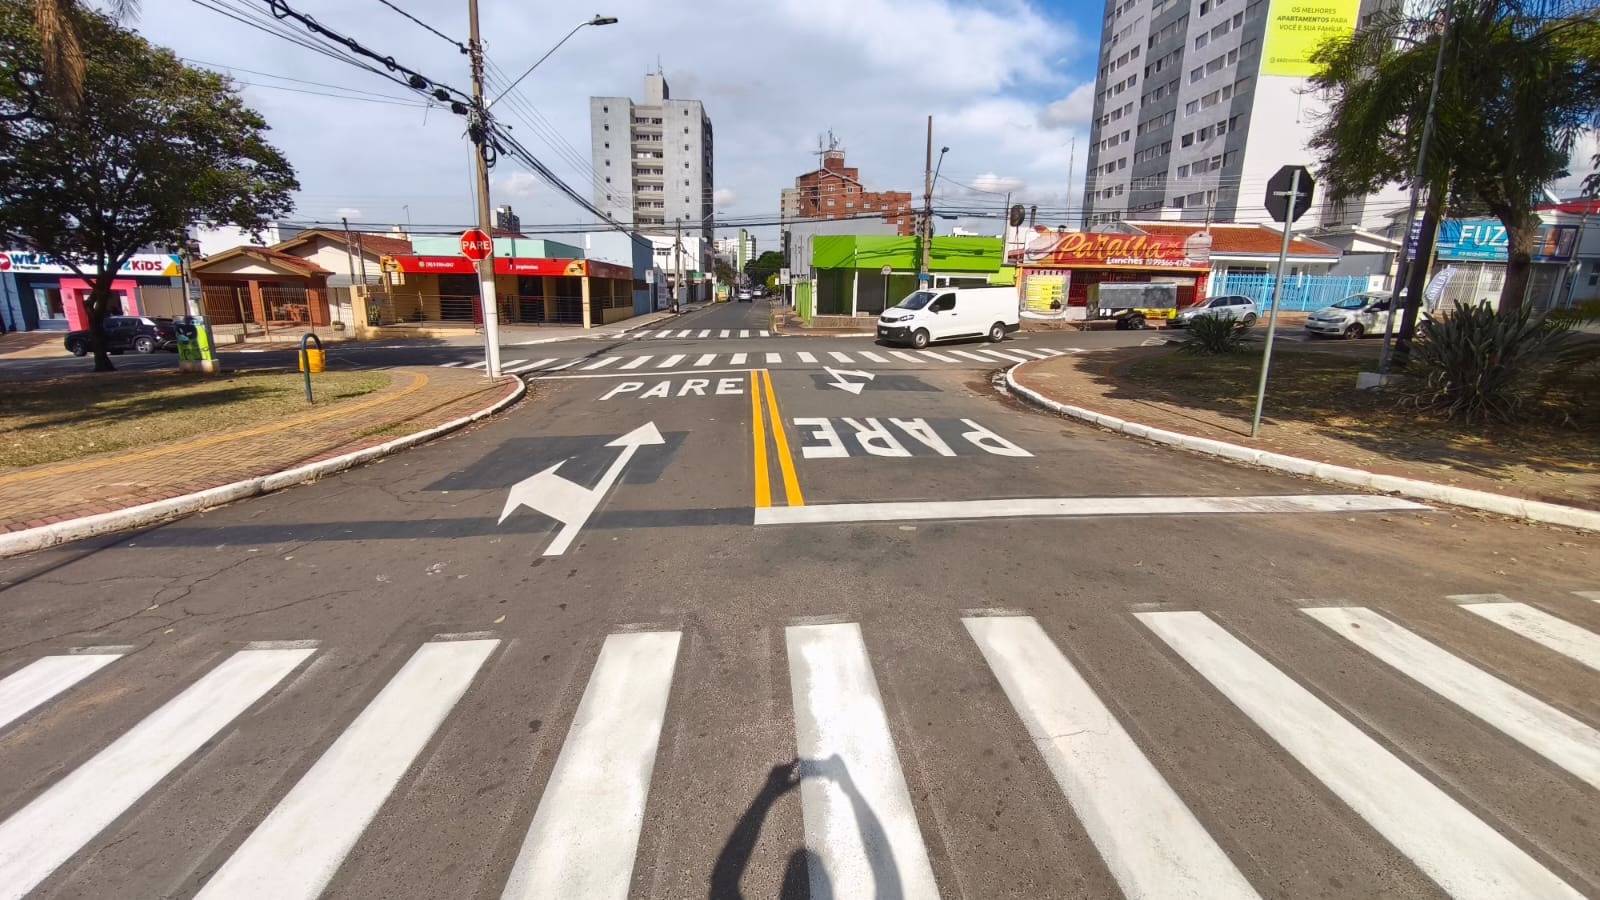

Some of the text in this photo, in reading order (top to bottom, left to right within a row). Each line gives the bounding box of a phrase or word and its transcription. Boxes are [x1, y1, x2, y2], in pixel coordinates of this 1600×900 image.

[1302, 7, 1336, 15] MELHORES
[1277, 15, 1329, 23] APARTAMENTOS
[462, 240, 491, 251] PARE
[1106, 256, 1143, 266] Lanches
[599, 377, 743, 401] PARE
[793, 417, 1036, 459] PARE
